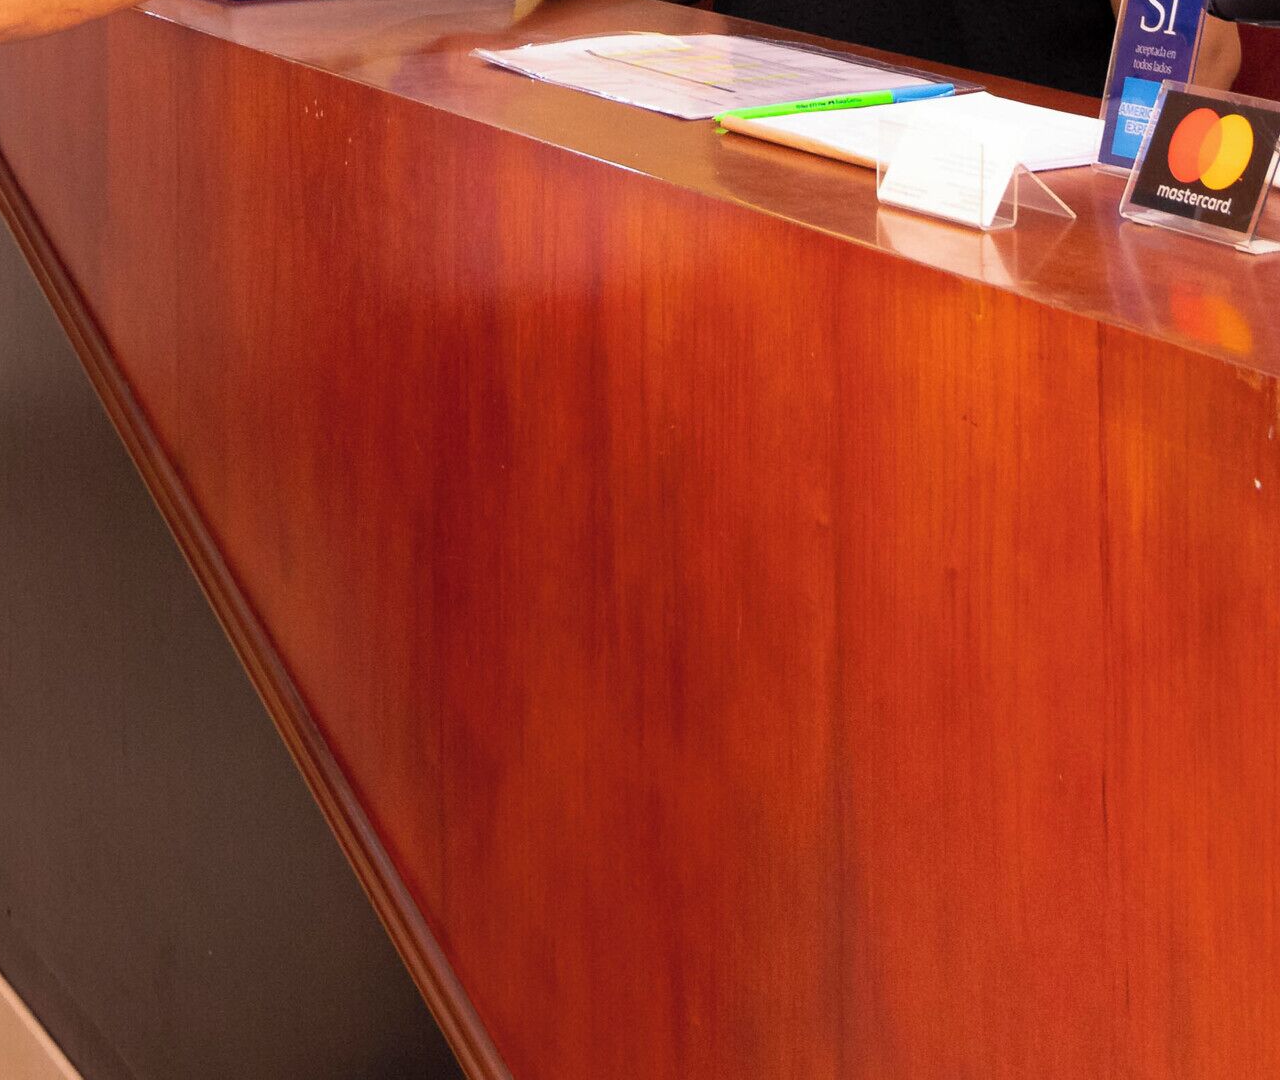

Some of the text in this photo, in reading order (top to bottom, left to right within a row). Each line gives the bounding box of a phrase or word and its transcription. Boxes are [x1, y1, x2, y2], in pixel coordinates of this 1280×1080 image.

[1135, 44, 1176, 59] aceptada en
[1133, 59, 1172, 74] todos lados
[1119, 102, 1161, 120] AMERIC
[1157, 183, 1231, 213] mastercard
